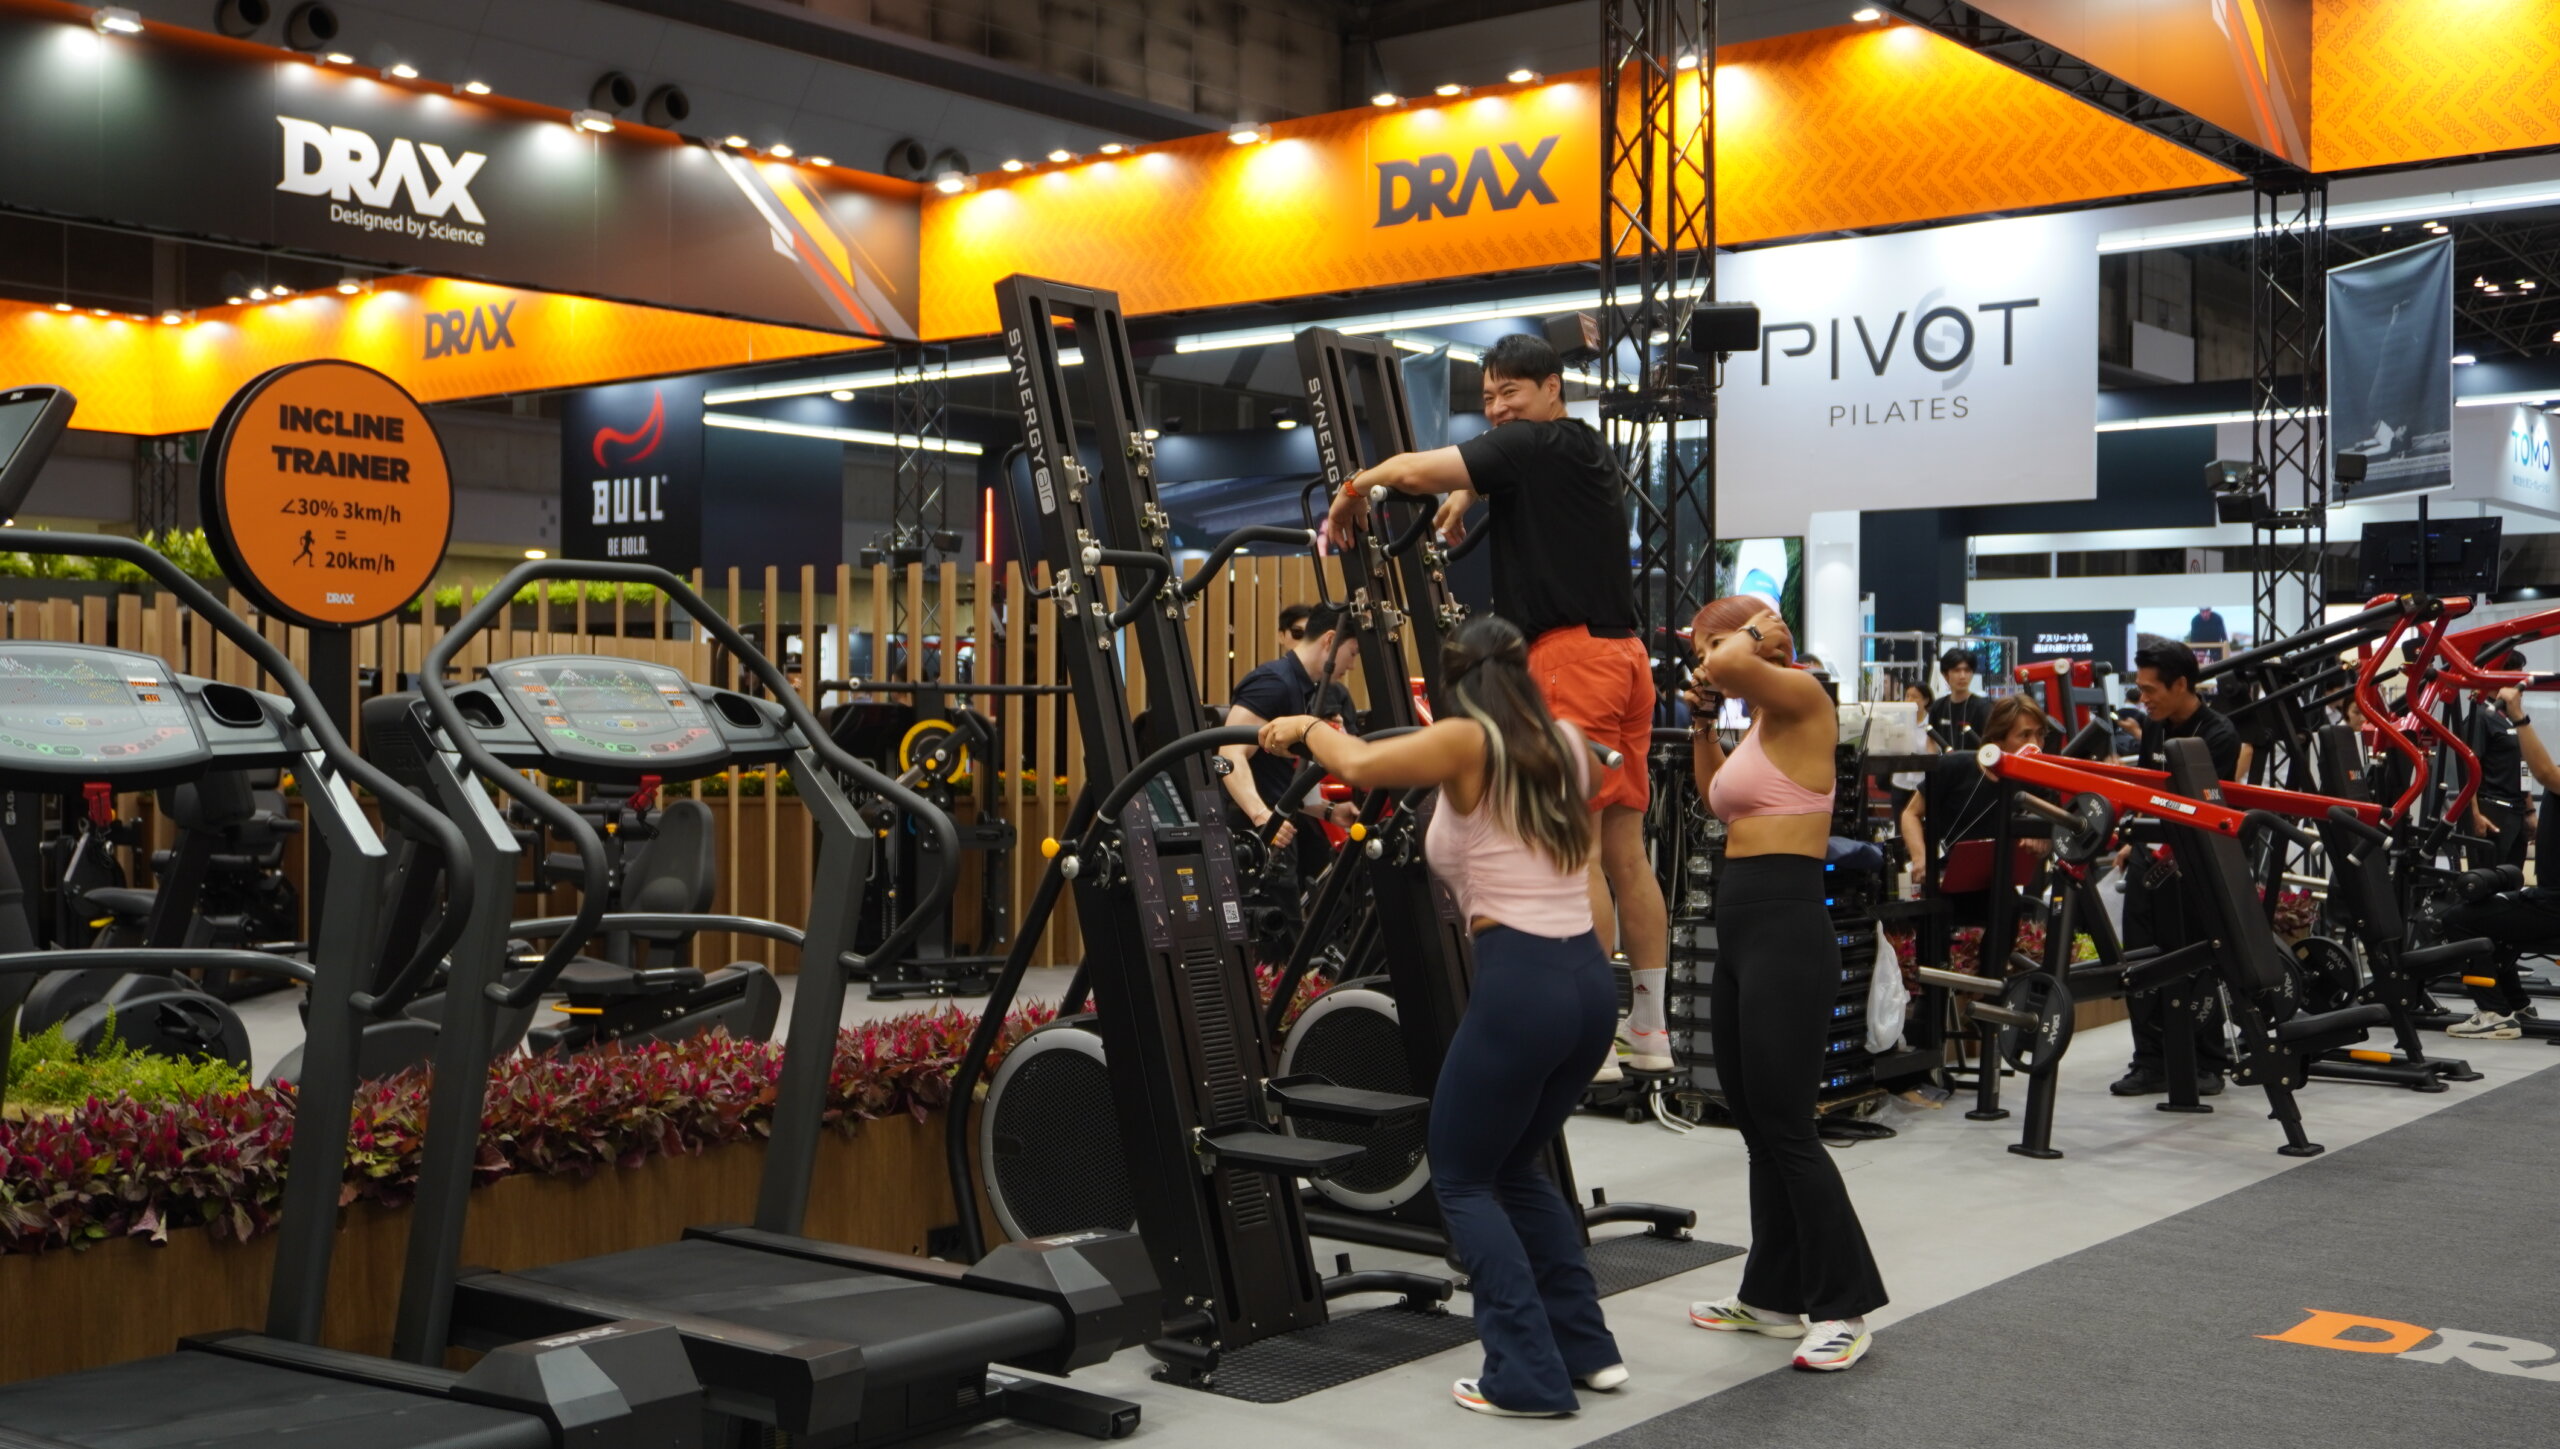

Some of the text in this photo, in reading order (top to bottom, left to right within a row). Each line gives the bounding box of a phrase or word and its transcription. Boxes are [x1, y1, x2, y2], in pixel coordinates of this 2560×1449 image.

[275, 115, 488, 226] DRAX
[1372, 133, 1561, 229] DRAX
[330, 204, 486, 246] Designed by Science
[422, 299, 517, 360] DRAX
[1761, 296, 2040, 386] PIVOT
[1008, 327, 1046, 464] SYNERGY
[1829, 395, 1969, 427] PILATES
[279, 403, 404, 444] INCLINE
[271, 444, 411, 484] TRAINER
[342, 501, 402, 526] 3km/h
[324, 551, 396, 575] 20km/h
[607, 537, 619, 557] BE
[326, 591, 355, 605] DRAX
[2042, 1021, 2050, 1033] 10
[2047, 1013, 2061, 1046] DRAX
[2252, 1307, 2560, 1382] DR
